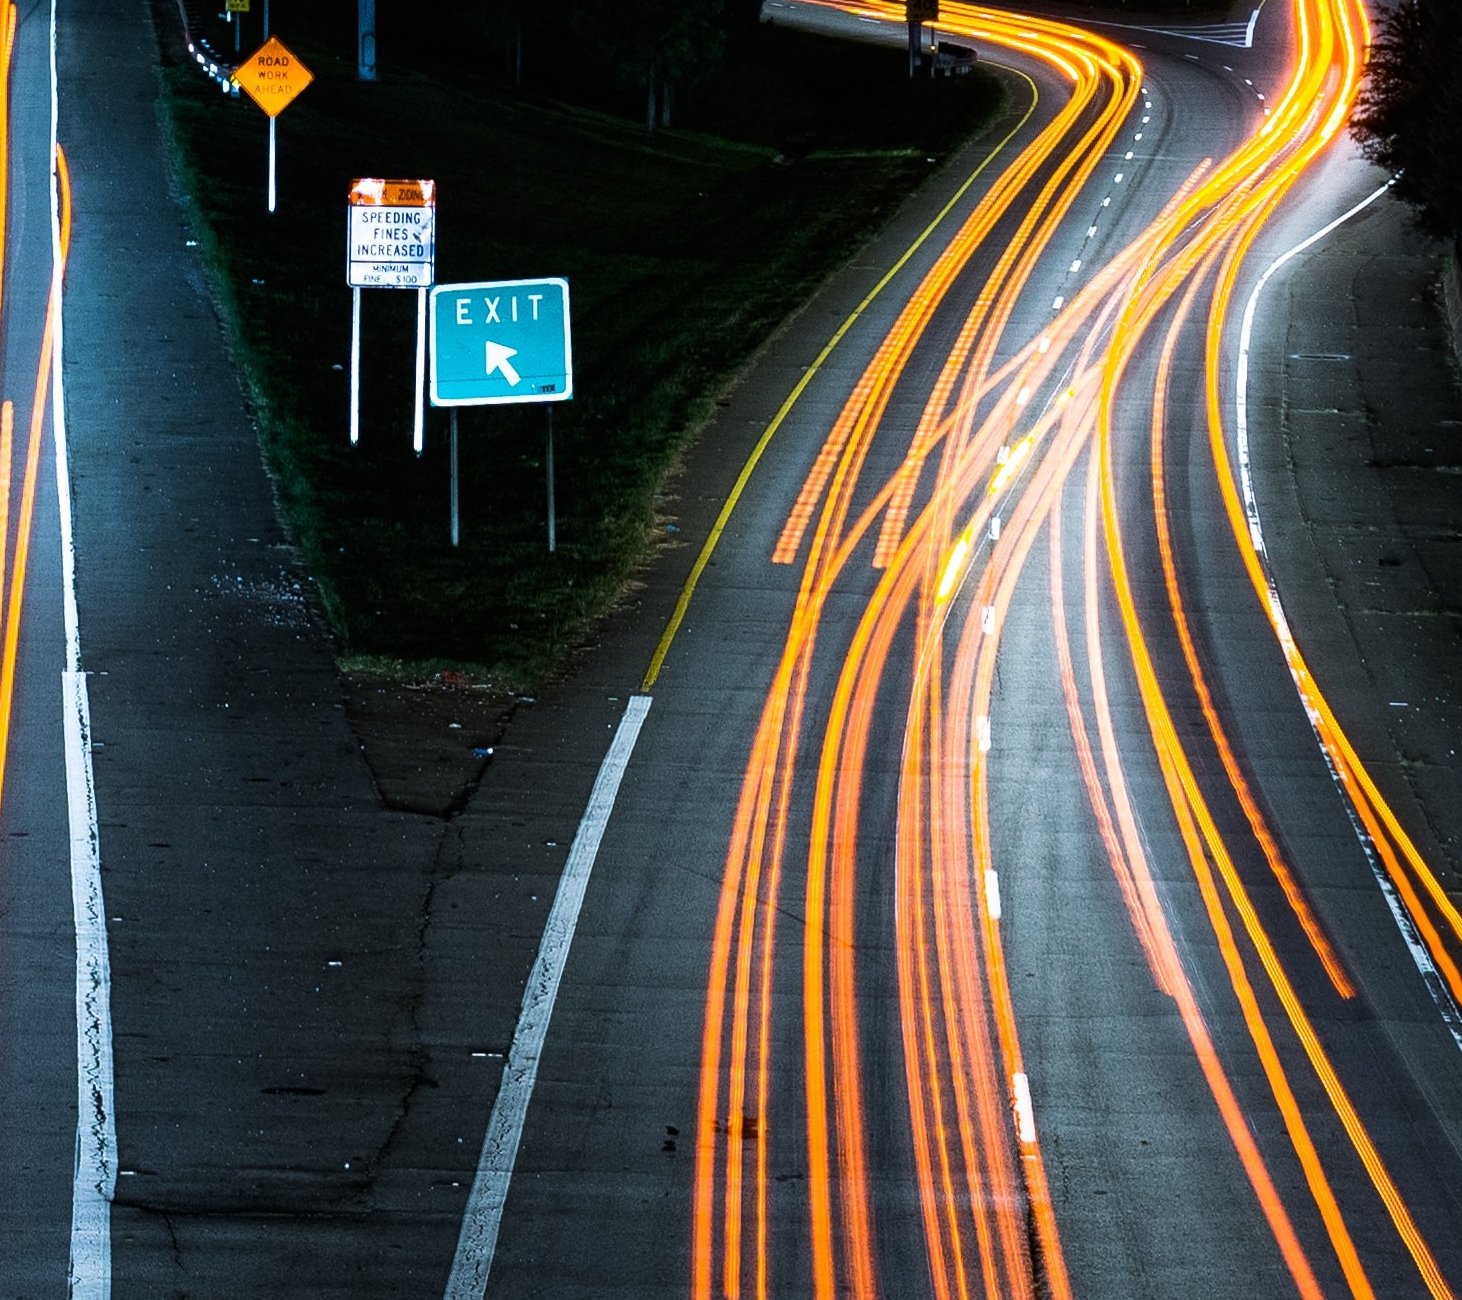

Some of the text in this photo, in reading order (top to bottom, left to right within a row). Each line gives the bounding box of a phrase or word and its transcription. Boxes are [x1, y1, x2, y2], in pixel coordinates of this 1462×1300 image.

[258, 56, 289, 67] ROAD
[258, 70, 288, 80] WORK
[254, 84, 293, 95] AHEAD
[362, 211, 421, 225] SPEEDING
[374, 227, 409, 241] FINES
[357, 244, 424, 258] INCREASED
[372, 264, 410, 274] MINIMUM
[456, 294, 543, 325] EXIT
